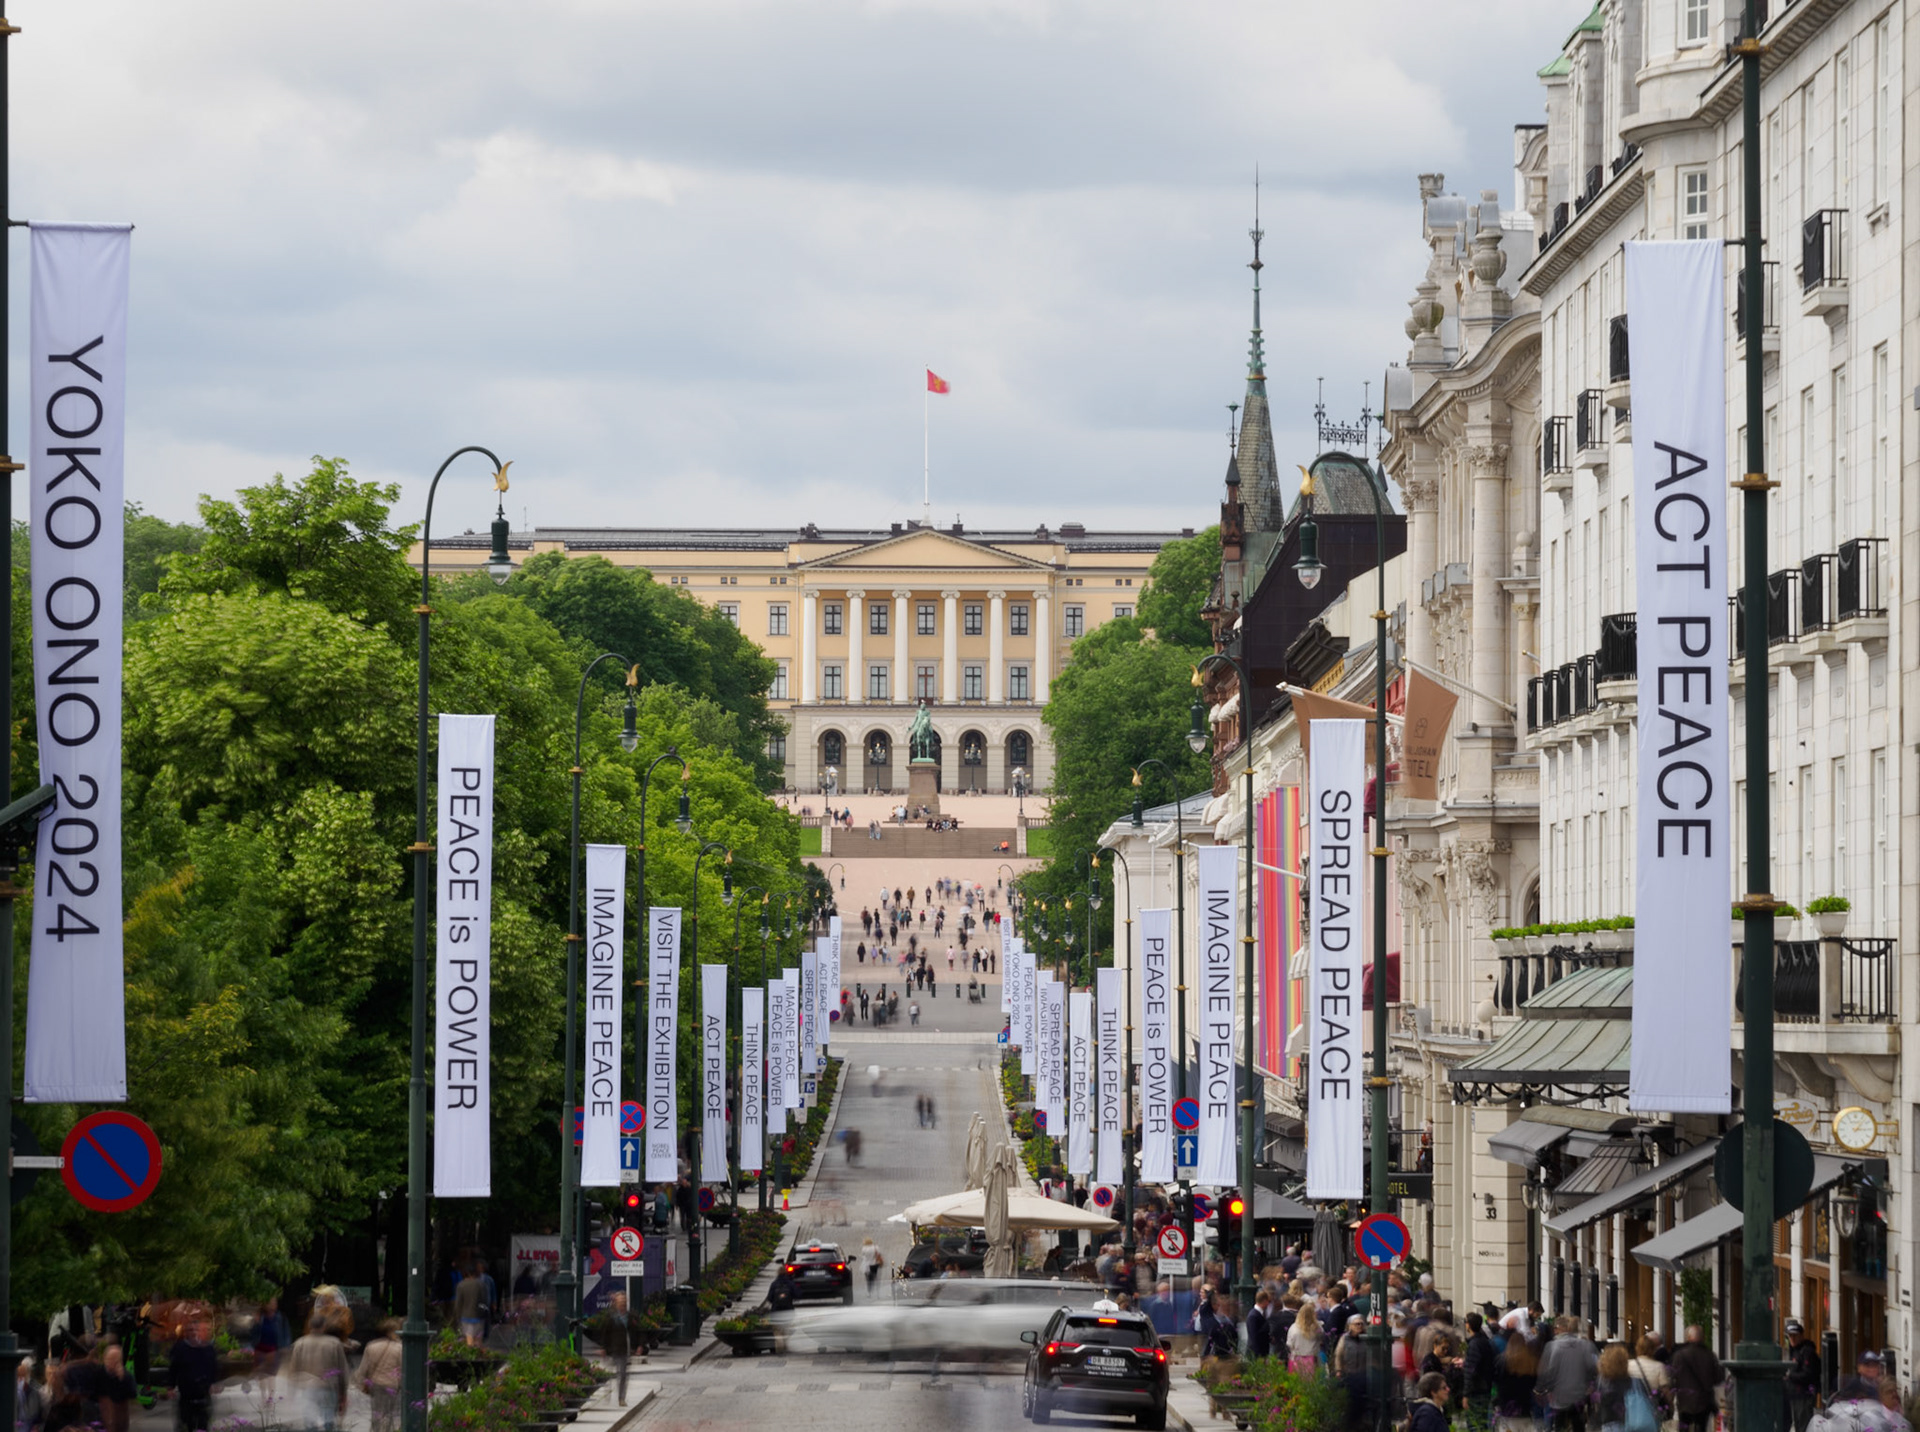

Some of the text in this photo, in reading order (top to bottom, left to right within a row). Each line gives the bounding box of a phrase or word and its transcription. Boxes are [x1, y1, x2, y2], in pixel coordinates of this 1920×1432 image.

[45, 334, 105, 944] YOKO ONO 2024
[1655, 440, 1713, 859] ACT PEACE
[447, 767, 482, 1110] PEACE is POWER
[819, 962, 828, 1014] ACT PEACE
[830, 934, 840, 989] THINK PEACE
[1002, 919, 1011, 995] VISIT THE EXHIBITION
[1012, 951, 1021, 1026] YOKO ONO 2024
[1320, 788, 1352, 1101] SPREAD PEACE
[591, 888, 616, 1117] IMAGINE PEACE
[653, 914, 674, 1131] VISIT THE EXHIBITION
[771, 995, 783, 1106] PEACE is POWER
[785, 985, 796, 1080] IMAGINE PEACE
[804, 968, 815, 1049] SPREAD PEACE
[1024, 966, 1034, 1055] PEACE is POWER
[1050, 1003, 1062, 1105] SPREAD PEACE
[1146, 937, 1167, 1134] PEACE is POWER
[1207, 889, 1231, 1119] IMAGINE PEACE
[706, 1014, 721, 1119] ACT PEACE
[745, 1022, 759, 1126] THINK PEACE
[1073, 1035, 1086, 1123] ACT PEACE
[1102, 1008, 1118, 1131] THINK PEACE
[1485, 1207, 1497, 1219] 33
